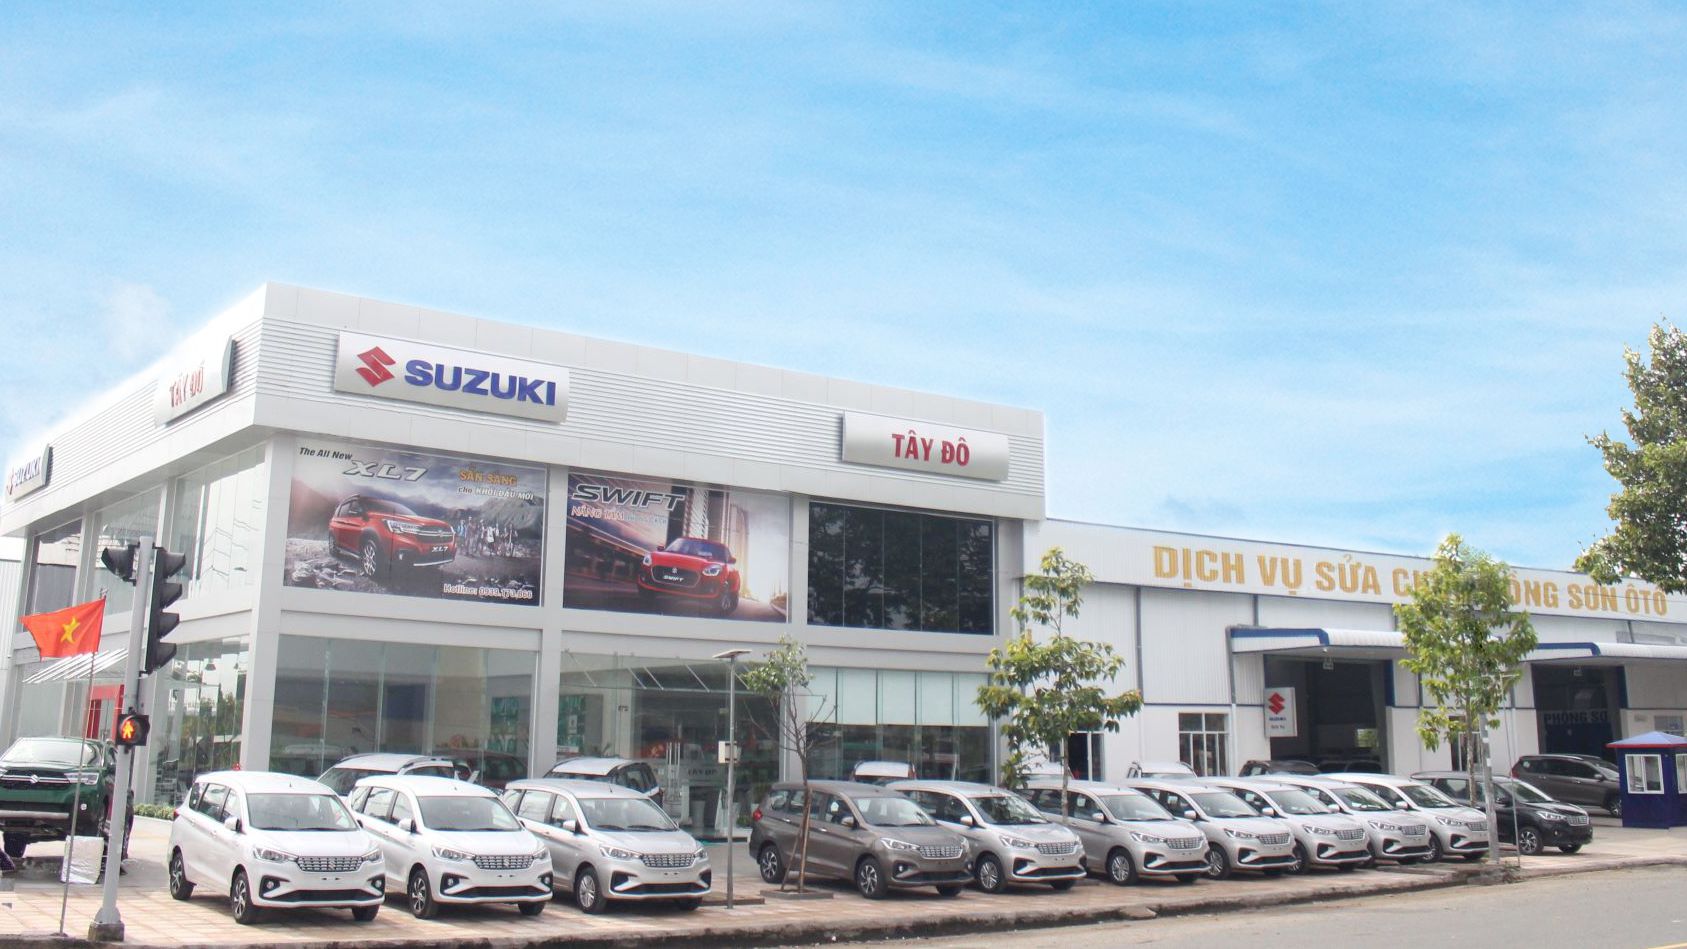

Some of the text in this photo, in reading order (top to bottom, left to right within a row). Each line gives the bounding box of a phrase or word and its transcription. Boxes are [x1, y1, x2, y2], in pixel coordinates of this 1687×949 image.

[404, 359, 556, 406] SUZUKI
[299, 447, 353, 461] The All New
[891, 429, 970, 467] TÂY ĐÔ
[343, 460, 428, 482] XL7
[458, 486, 473, 494] cho
[571, 483, 686, 513] SWIFT
[1153, 545, 1245, 588] DỊCH
[1257, 554, 1303, 596] VỤ
[1315, 554, 1382, 595] SỬA
[1566, 581, 1619, 613] SƠN
